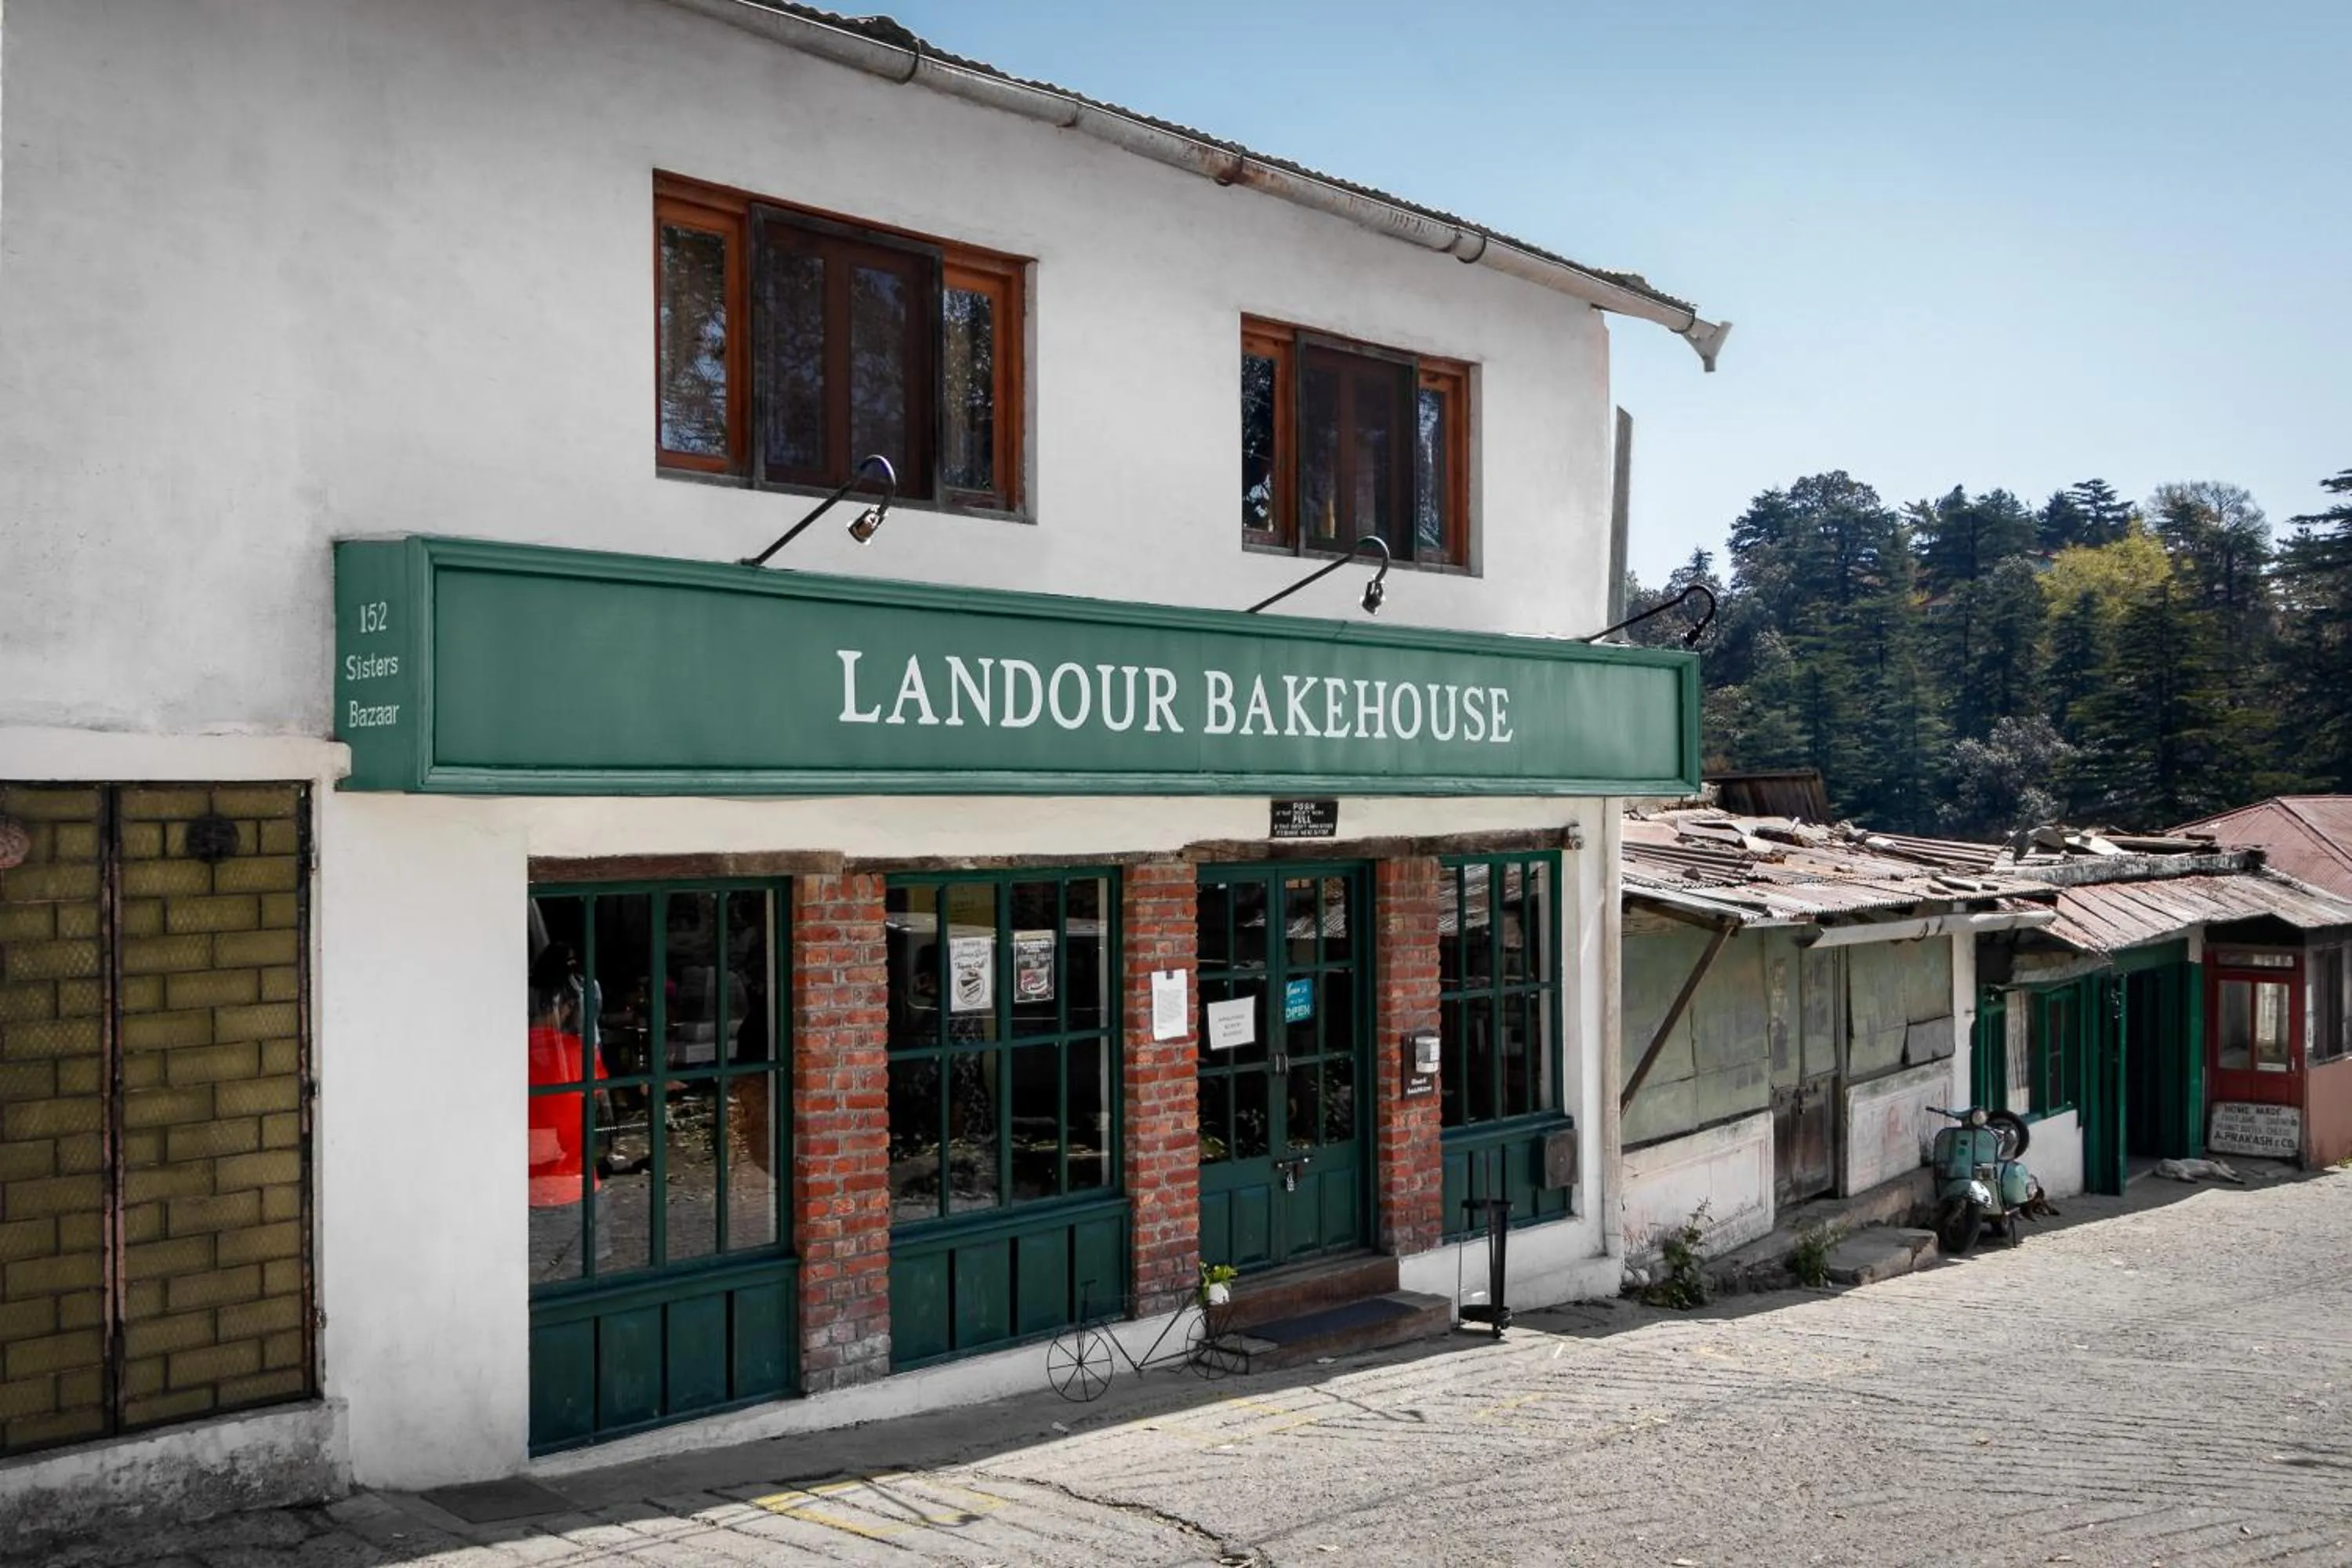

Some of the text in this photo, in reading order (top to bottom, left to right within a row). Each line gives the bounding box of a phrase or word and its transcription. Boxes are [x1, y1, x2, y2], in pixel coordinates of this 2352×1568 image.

[360, 601, 387, 633] 152
[346, 652, 399, 681] Sisters
[836, 649, 1515, 743] LANDOUR BAKEHOUSE
[349, 700, 401, 728] Bazaar
